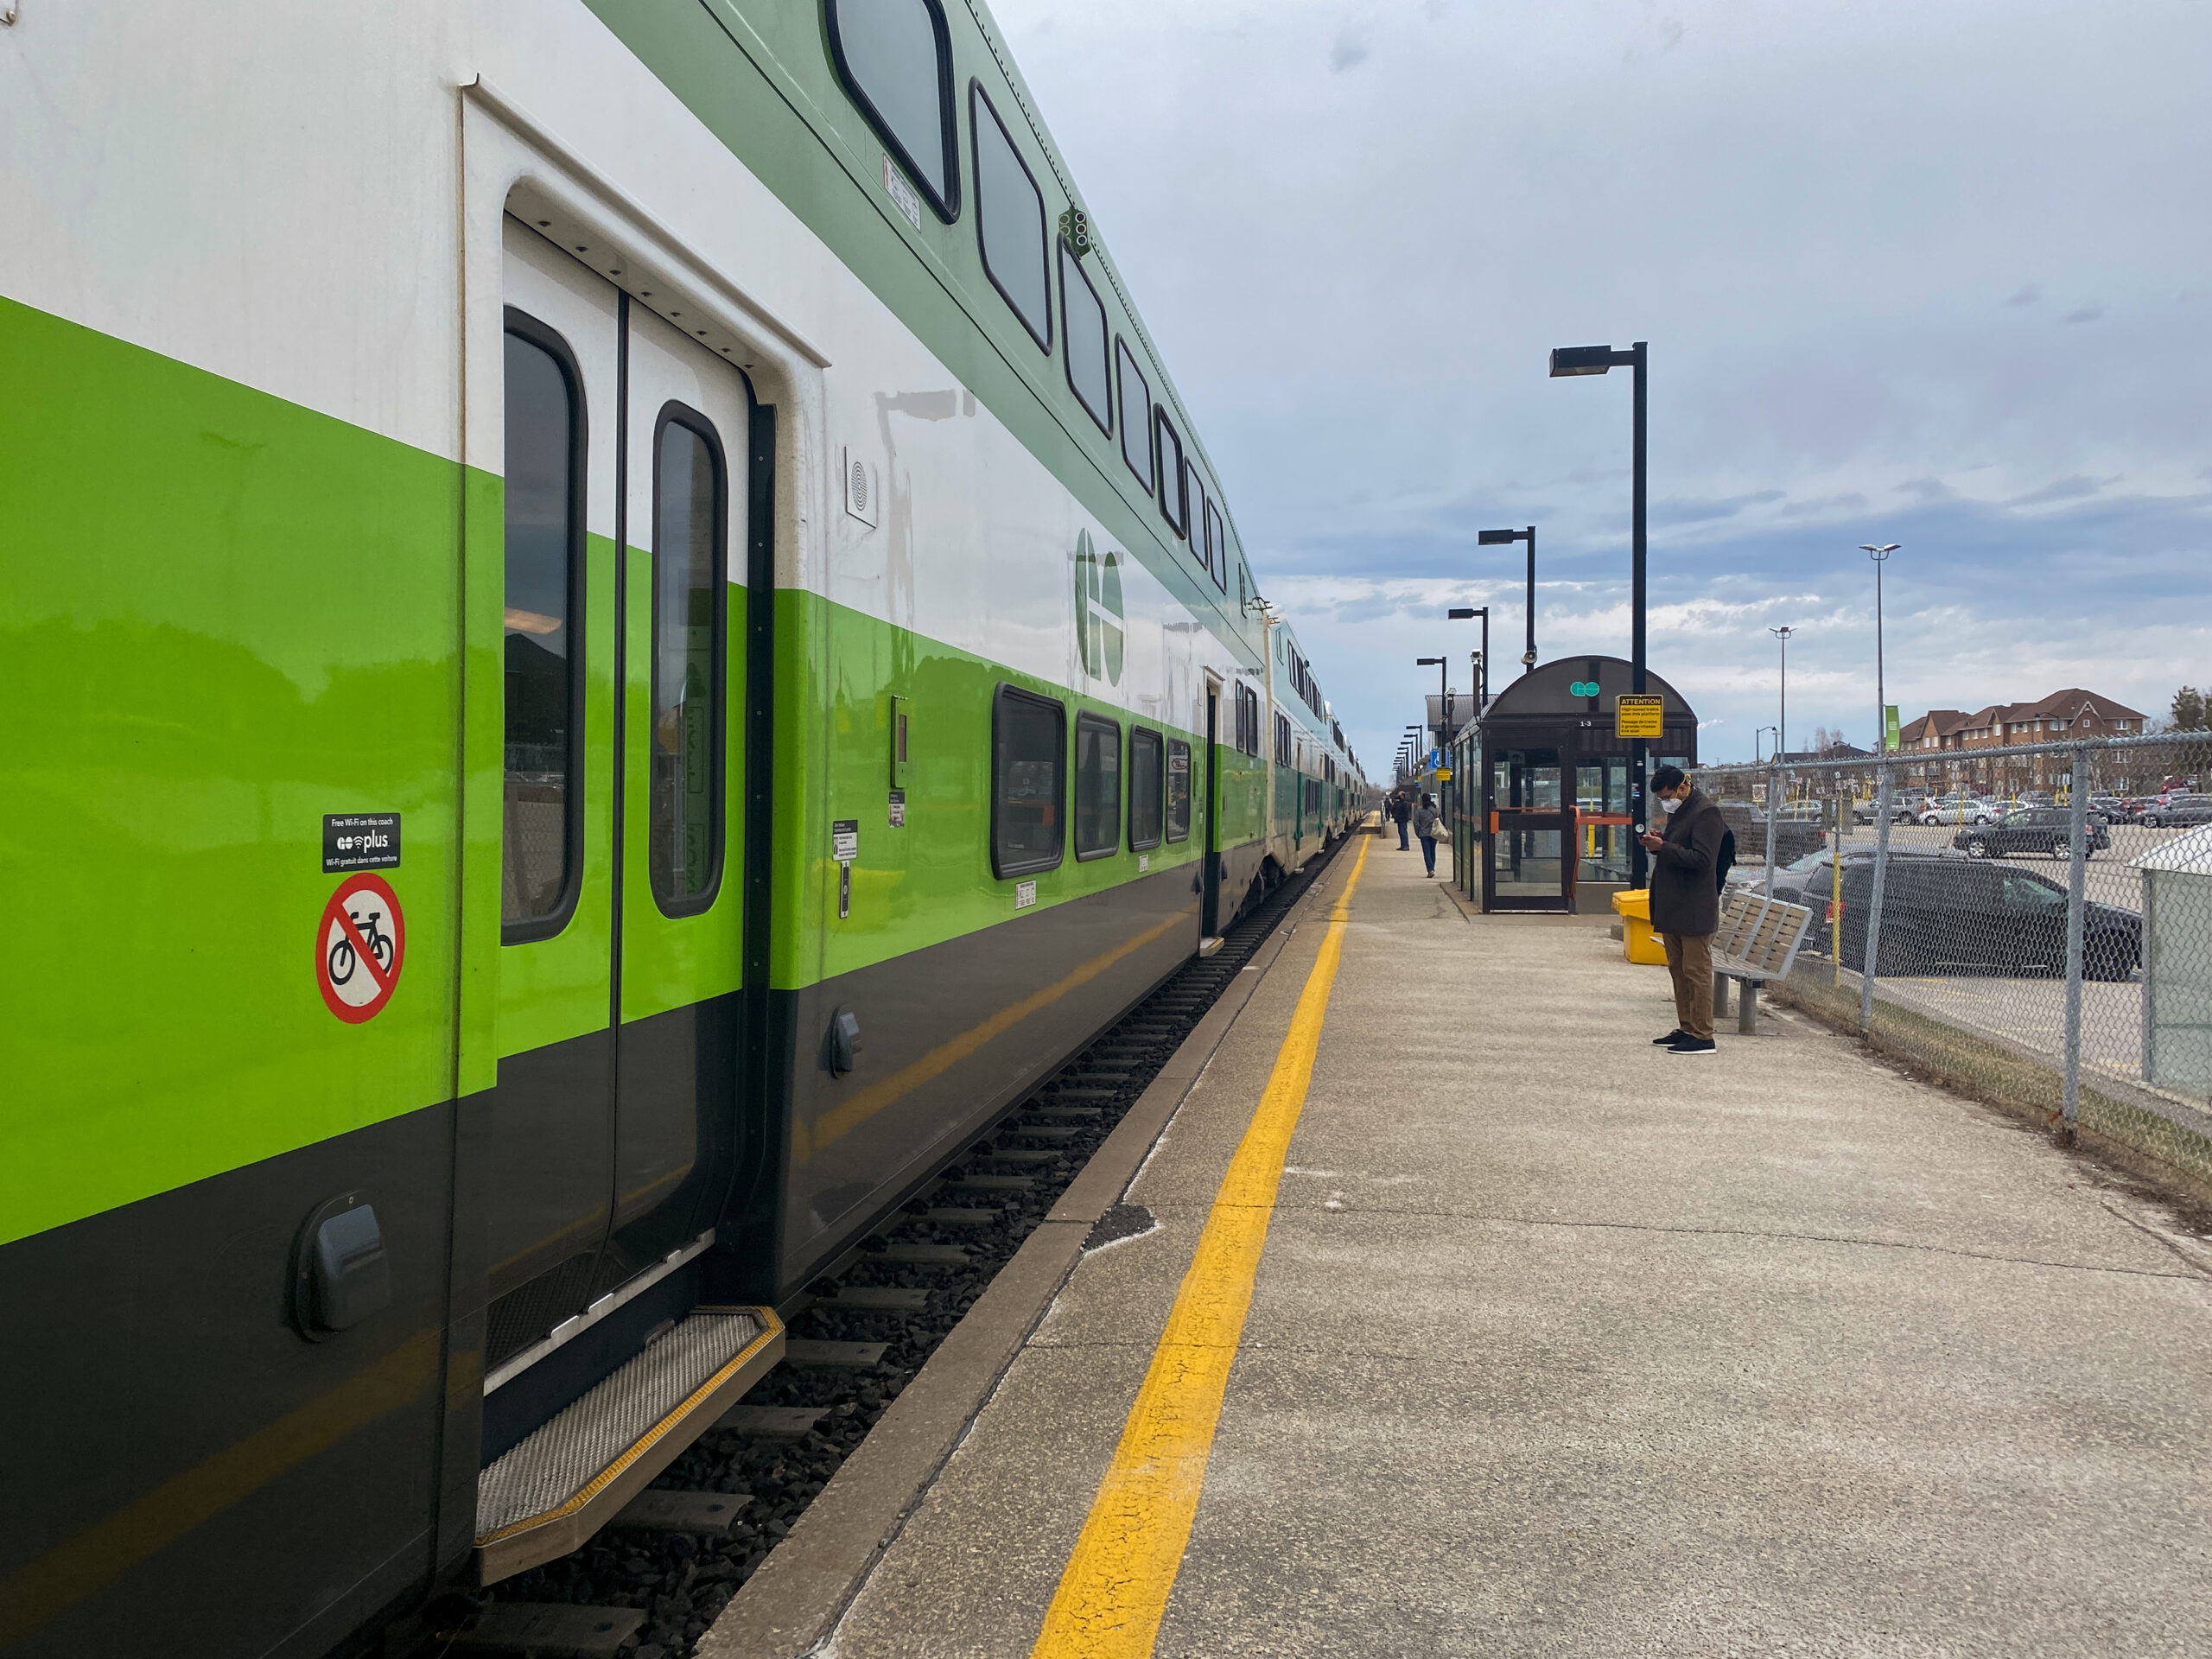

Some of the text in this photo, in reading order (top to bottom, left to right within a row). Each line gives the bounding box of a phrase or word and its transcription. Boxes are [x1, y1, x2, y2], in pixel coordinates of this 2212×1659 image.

[331, 818, 344, 827] Free
[344, 818, 359, 827] Wi-Fi
[367, 817, 378, 826] this
[378, 817, 393, 825] coach
[364, 829, 388, 854] plus
[326, 858, 340, 867] Wi-Fi
[340, 857, 357, 868] gratuit
